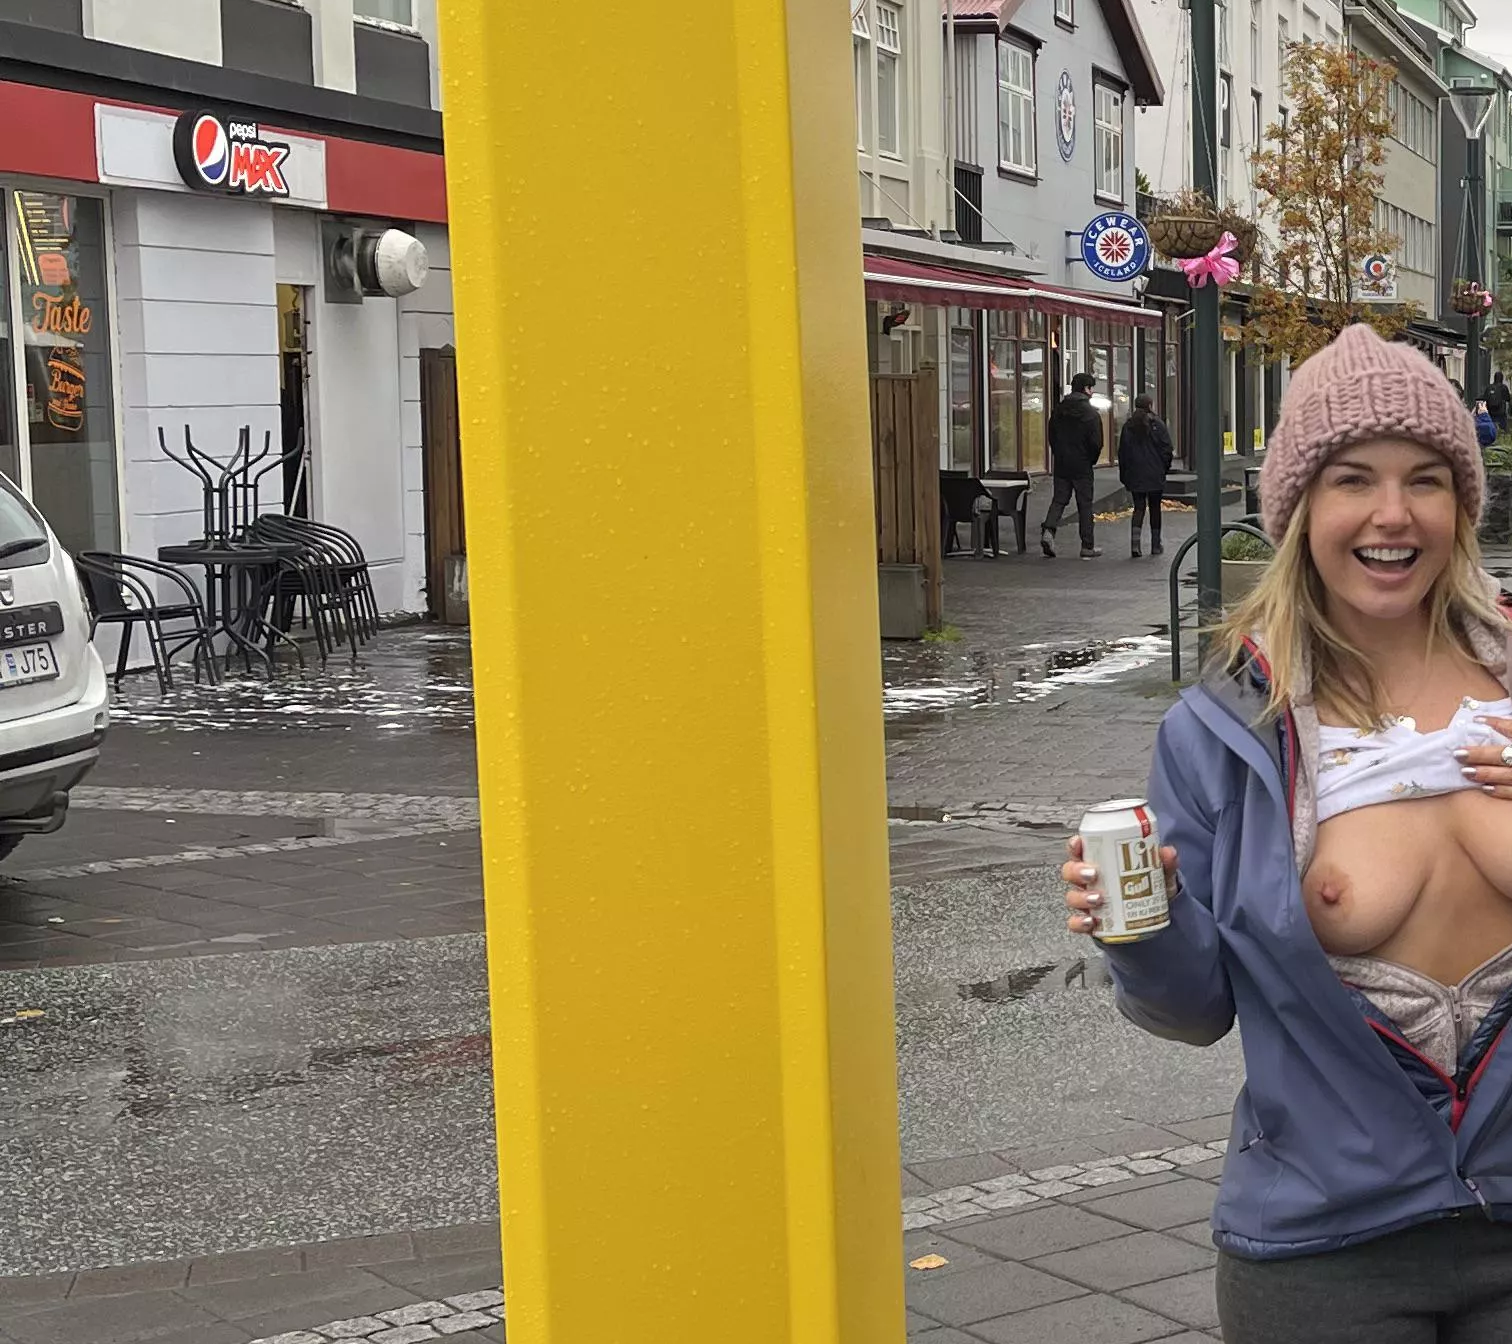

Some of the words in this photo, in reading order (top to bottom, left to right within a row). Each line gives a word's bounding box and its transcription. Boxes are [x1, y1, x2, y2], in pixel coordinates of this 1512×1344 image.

[229, 123, 257, 140] pepsi
[229, 141, 288, 194] MAX
[1085, 217, 1144, 246] ICEWEAR
[1093, 261, 1136, 276] ICELAND
[32, 291, 92, 335] Taste
[48, 369, 84, 398] Burger
[21, 647, 49, 674] J75
[1124, 875, 1149, 896] Gull
